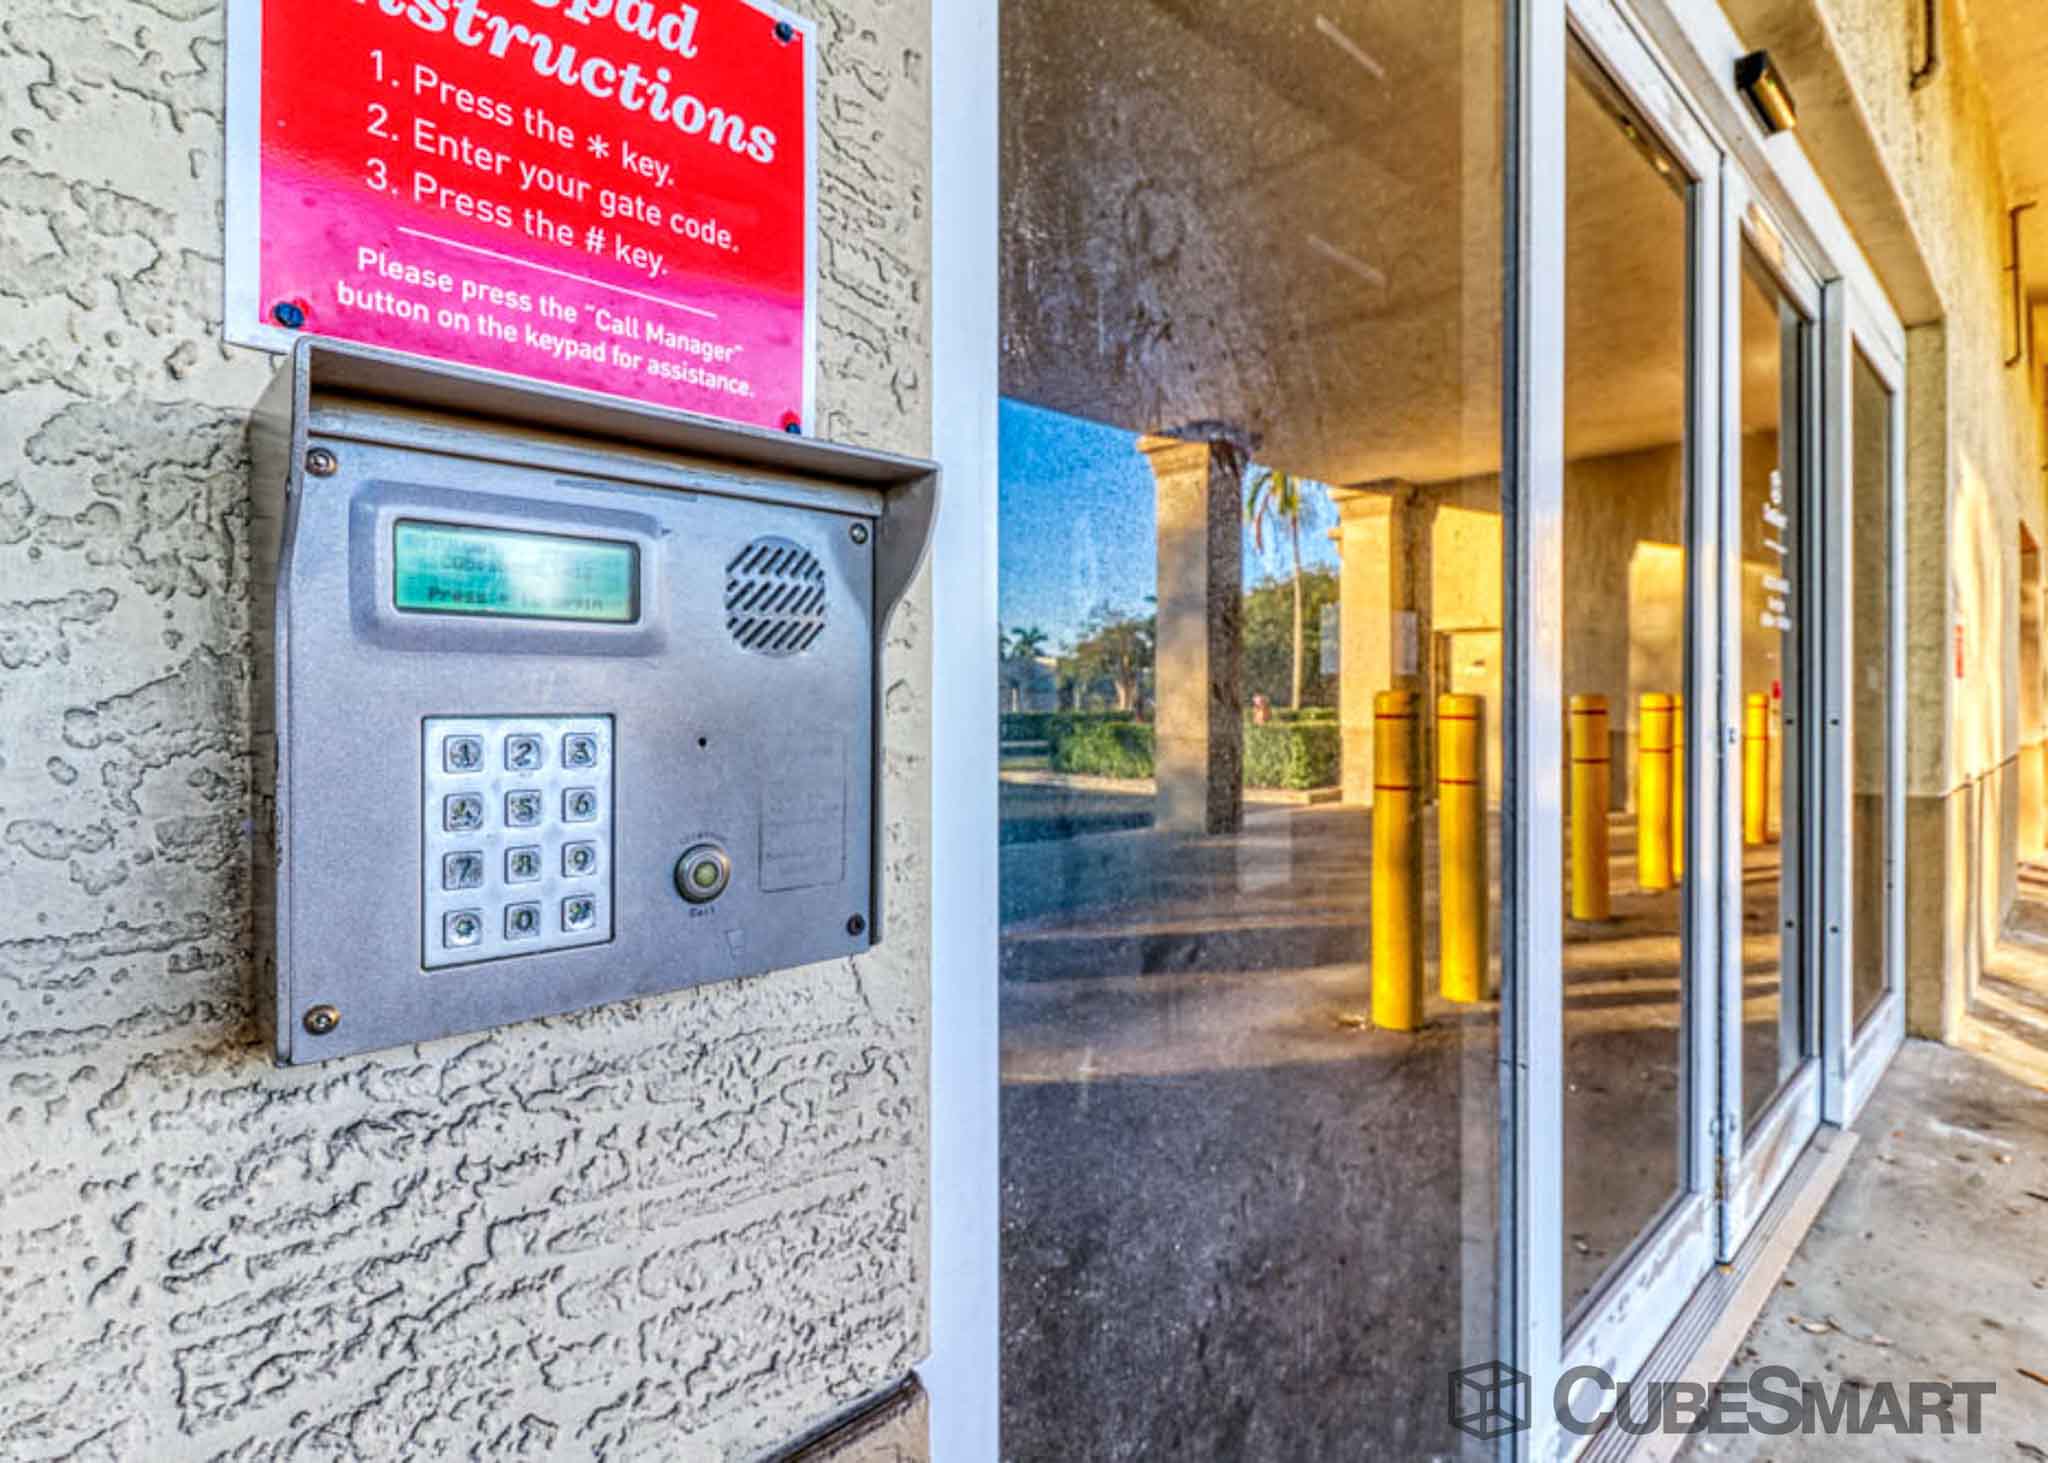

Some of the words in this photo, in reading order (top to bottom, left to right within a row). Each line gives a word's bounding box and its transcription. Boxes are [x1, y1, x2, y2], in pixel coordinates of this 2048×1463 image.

[366, 102, 400, 142] 2.
[413, 117, 512, 176] Enter
[518, 159, 592, 203] your
[599, 188, 663, 227] gate
[669, 212, 741, 254] code.
[370, 49, 400, 88] 1.
[413, 63, 514, 127] Press
[523, 107, 575, 149] the
[621, 140, 676, 188] key.
[365, 157, 400, 195] 3.
[413, 171, 513, 229] Press
[523, 208, 574, 247] the
[585, 225, 607, 255] #
[614, 233, 669, 279] key.
[337, 279, 430, 323] button
[437, 308, 471, 333] on
[476, 313, 519, 343] the
[524, 322, 606, 363] keypad
[611, 343, 643, 370] for
[647, 356, 757, 398] assistance.
[357, 246, 455, 293] Please
[461, 279, 533, 314] press
[539, 294, 578, 324] the
[511, 741, 533, 767] 2
